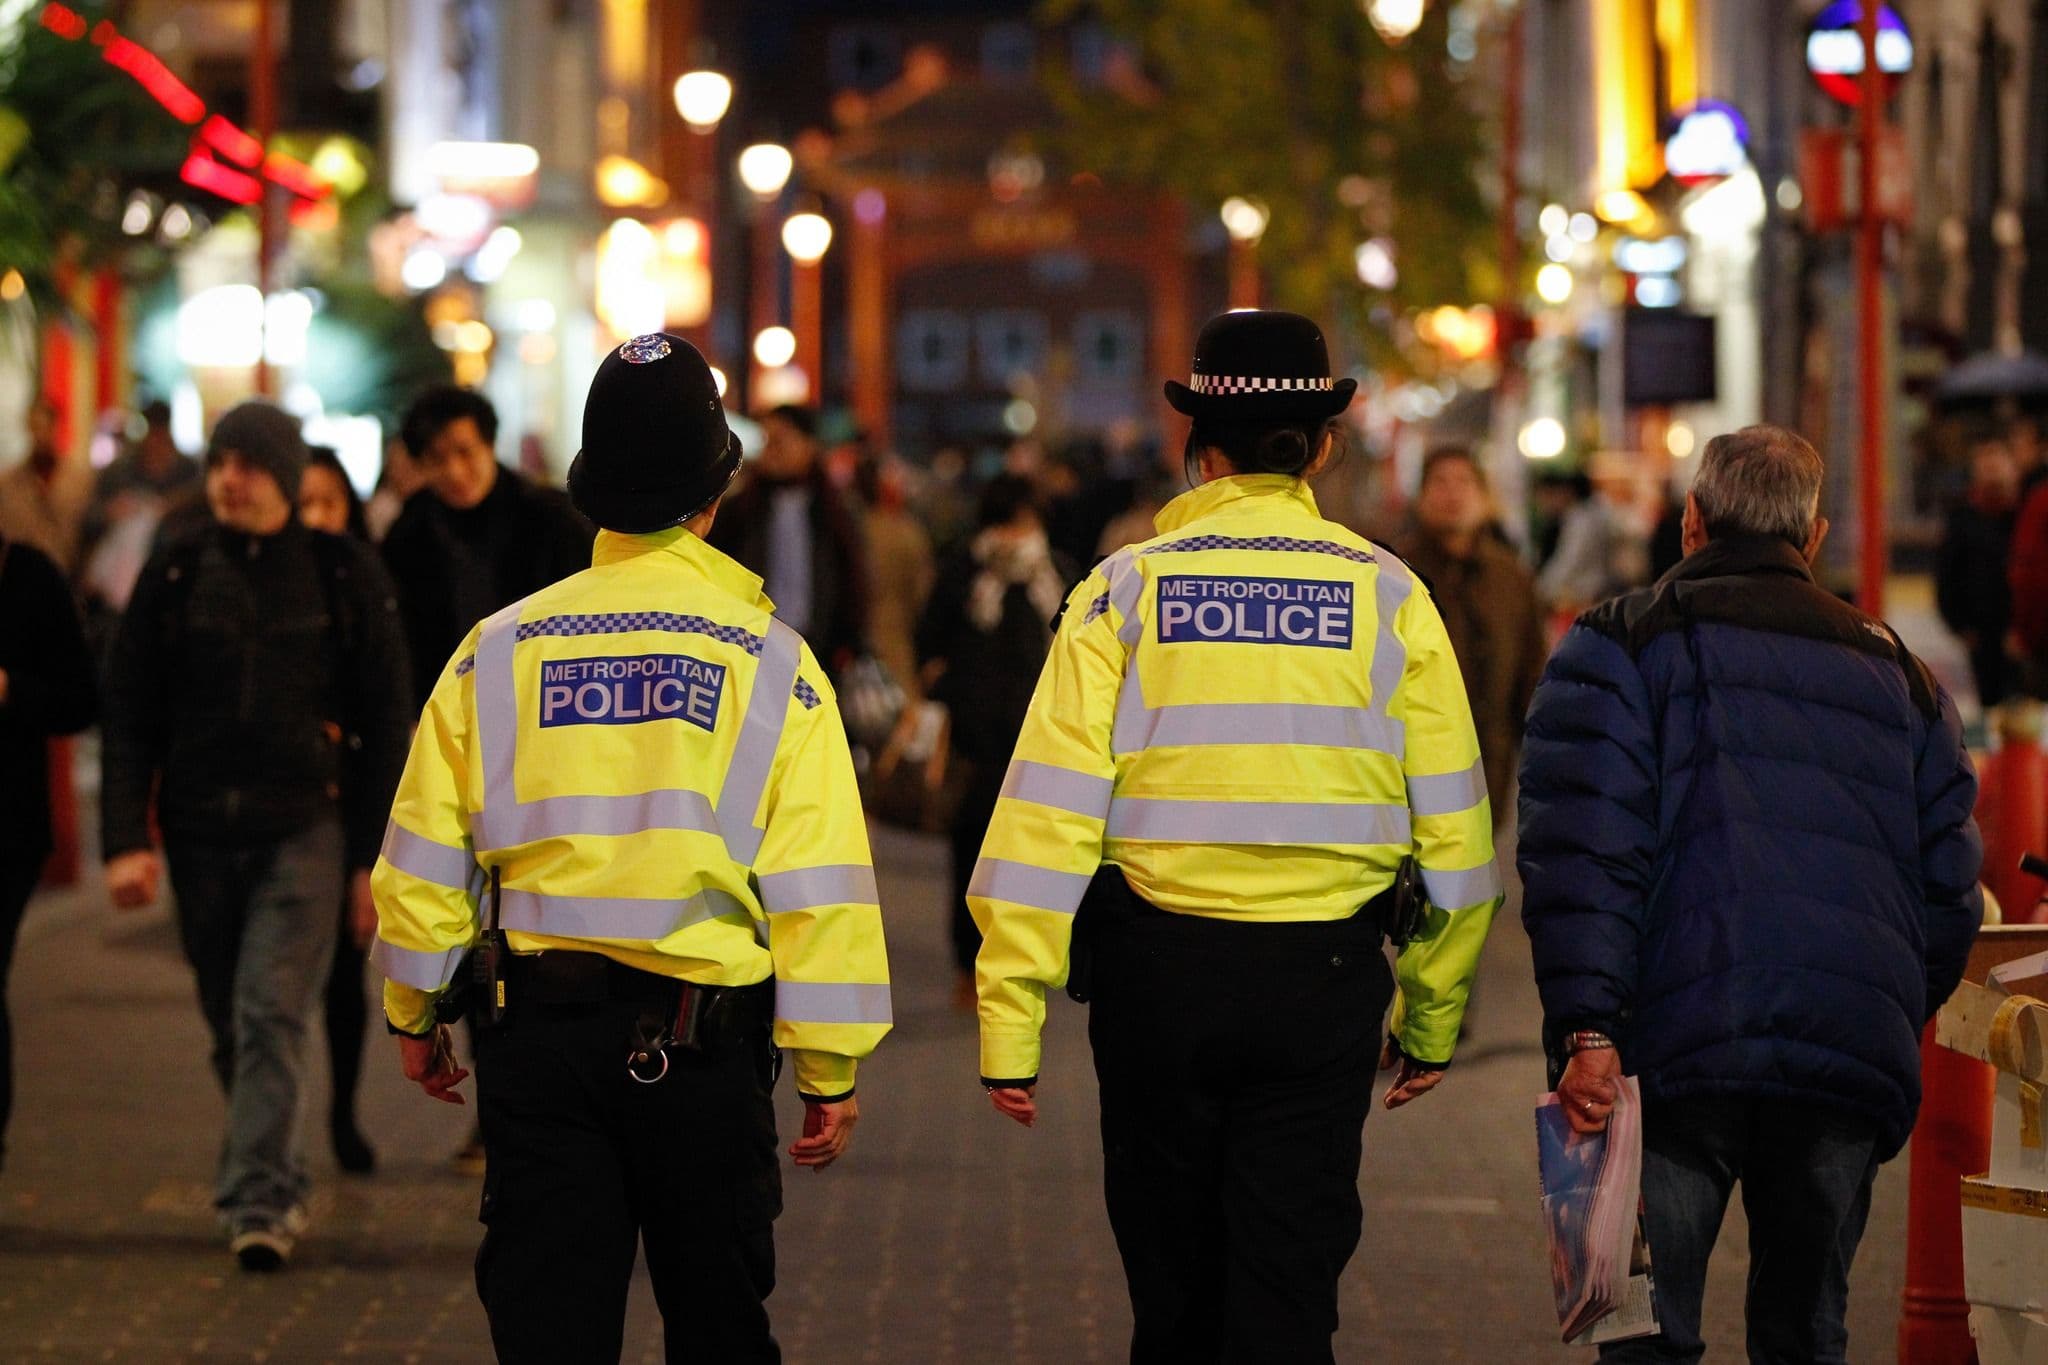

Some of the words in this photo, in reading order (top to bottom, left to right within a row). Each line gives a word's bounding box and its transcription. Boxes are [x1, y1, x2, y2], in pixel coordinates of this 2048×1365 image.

[1161, 580, 1350, 603] METROPOLITAN
[1162, 600, 1349, 643] POLICE
[545, 658, 721, 687] METROPOLITAN
[543, 678, 716, 725] POLICE
